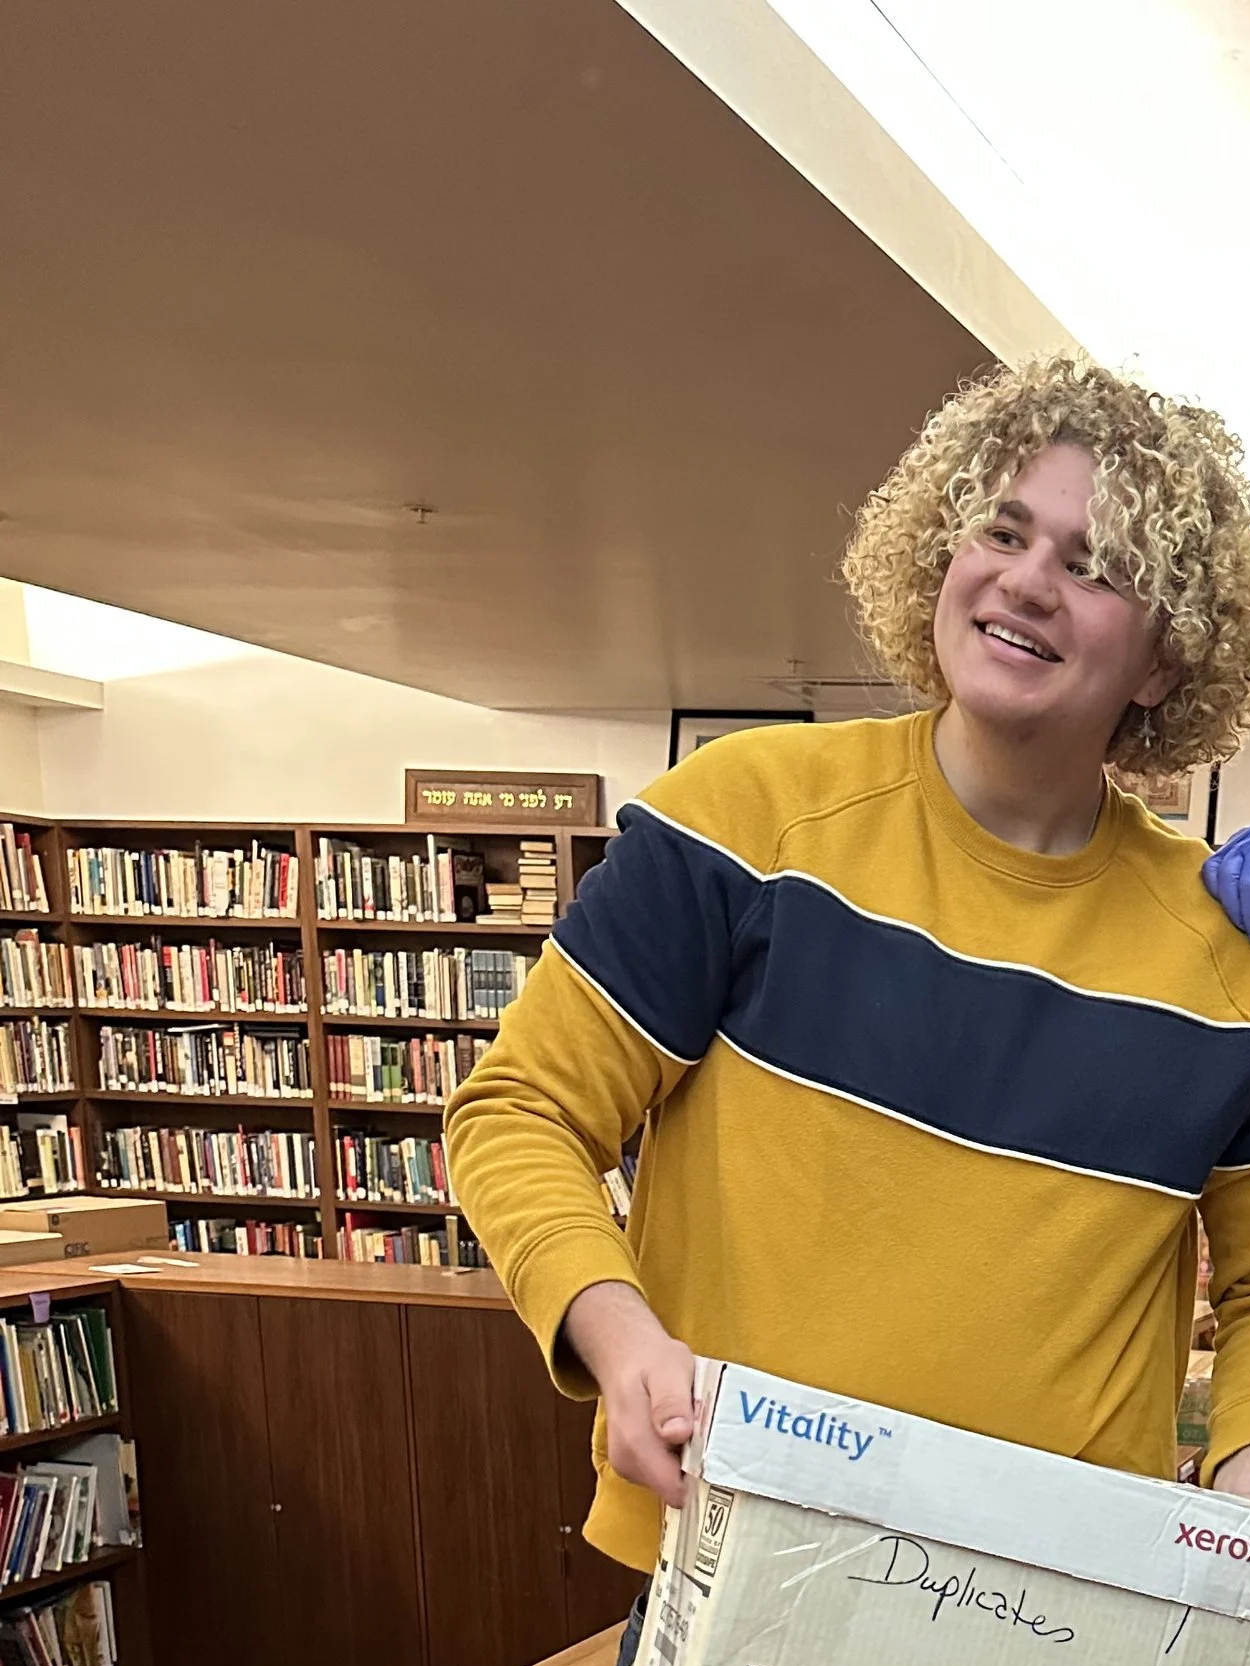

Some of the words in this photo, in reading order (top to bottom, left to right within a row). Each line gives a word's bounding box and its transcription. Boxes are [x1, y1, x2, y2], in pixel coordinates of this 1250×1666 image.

[518, 789, 547, 808] לפני
[554, 793, 573, 811] דע
[848, 1536, 1075, 1643] Duplicates
